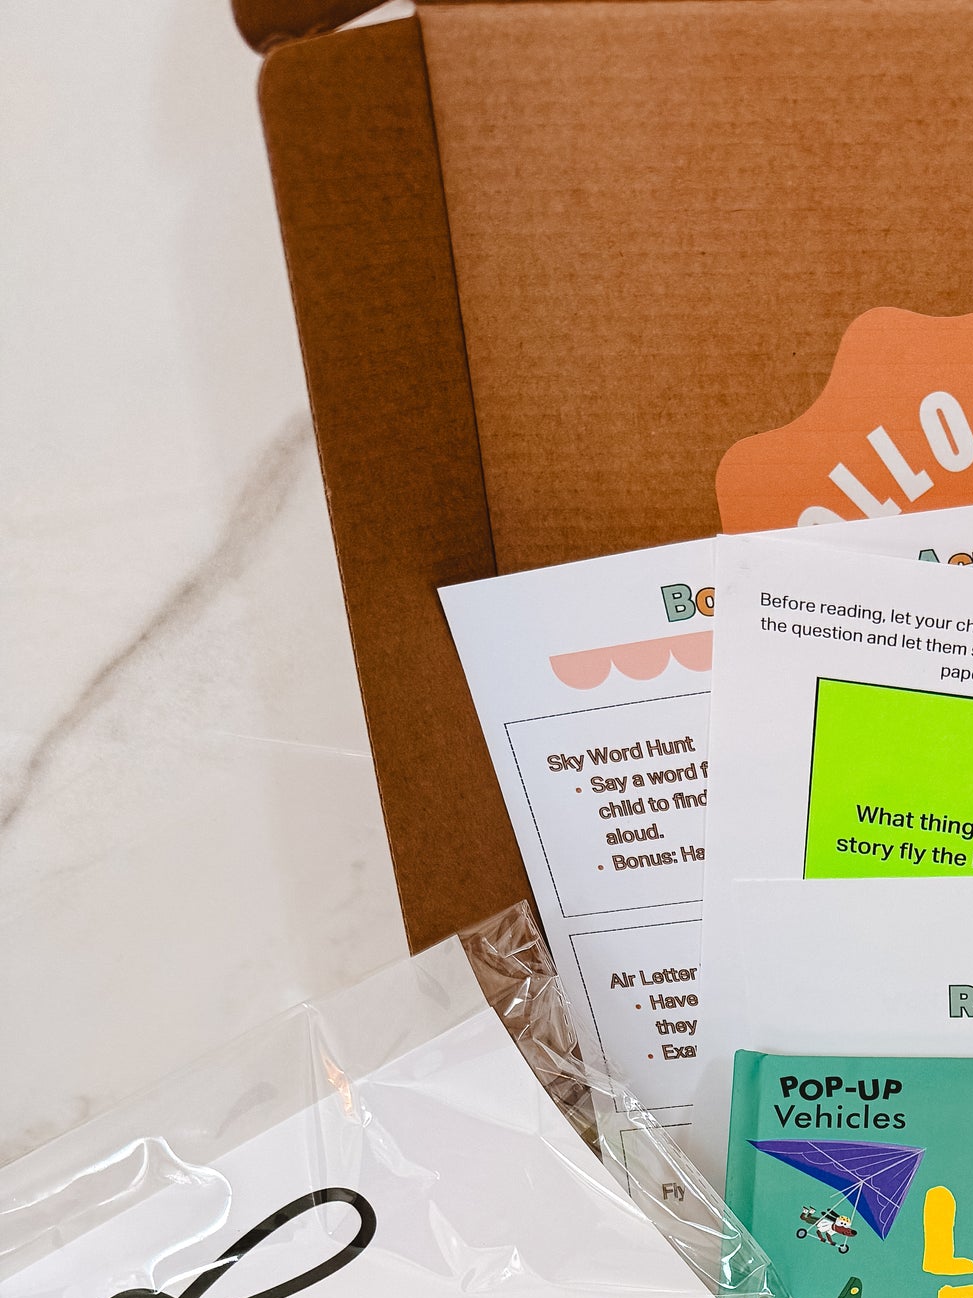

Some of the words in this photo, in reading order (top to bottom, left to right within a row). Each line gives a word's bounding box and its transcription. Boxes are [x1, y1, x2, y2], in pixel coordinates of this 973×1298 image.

[760, 591, 817, 614] Before
[819, 602, 887, 625] reading,
[890, 608, 913, 626] let
[913, 615, 954, 631] your
[760, 616, 788, 634] the
[791, 623, 864, 643] question
[866, 632, 898, 648] and
[901, 633, 923, 651] let
[925, 637, 968, 657] them
[546, 753, 586, 773] Sky
[586, 742, 644, 767] Word
[646, 735, 696, 758] Hunt
[590, 775, 629, 795] Say
[647, 763, 698, 784] word
[598, 796, 646, 820] child
[672, 789, 708, 810] find
[855, 803, 916, 830] What
[605, 823, 666, 846] aloud.
[612, 850, 679, 872] Bonus:
[835, 836, 895, 862] story
[898, 841, 928, 866] fly
[931, 846, 968, 867] the
[609, 971, 637, 990] Air
[639, 966, 698, 987] Letter
[649, 993, 699, 1011] Have
[655, 1019, 698, 1036] they
[779, 1075, 903, 1101] POP-UP
[773, 1104, 906, 1130] Vehicles
